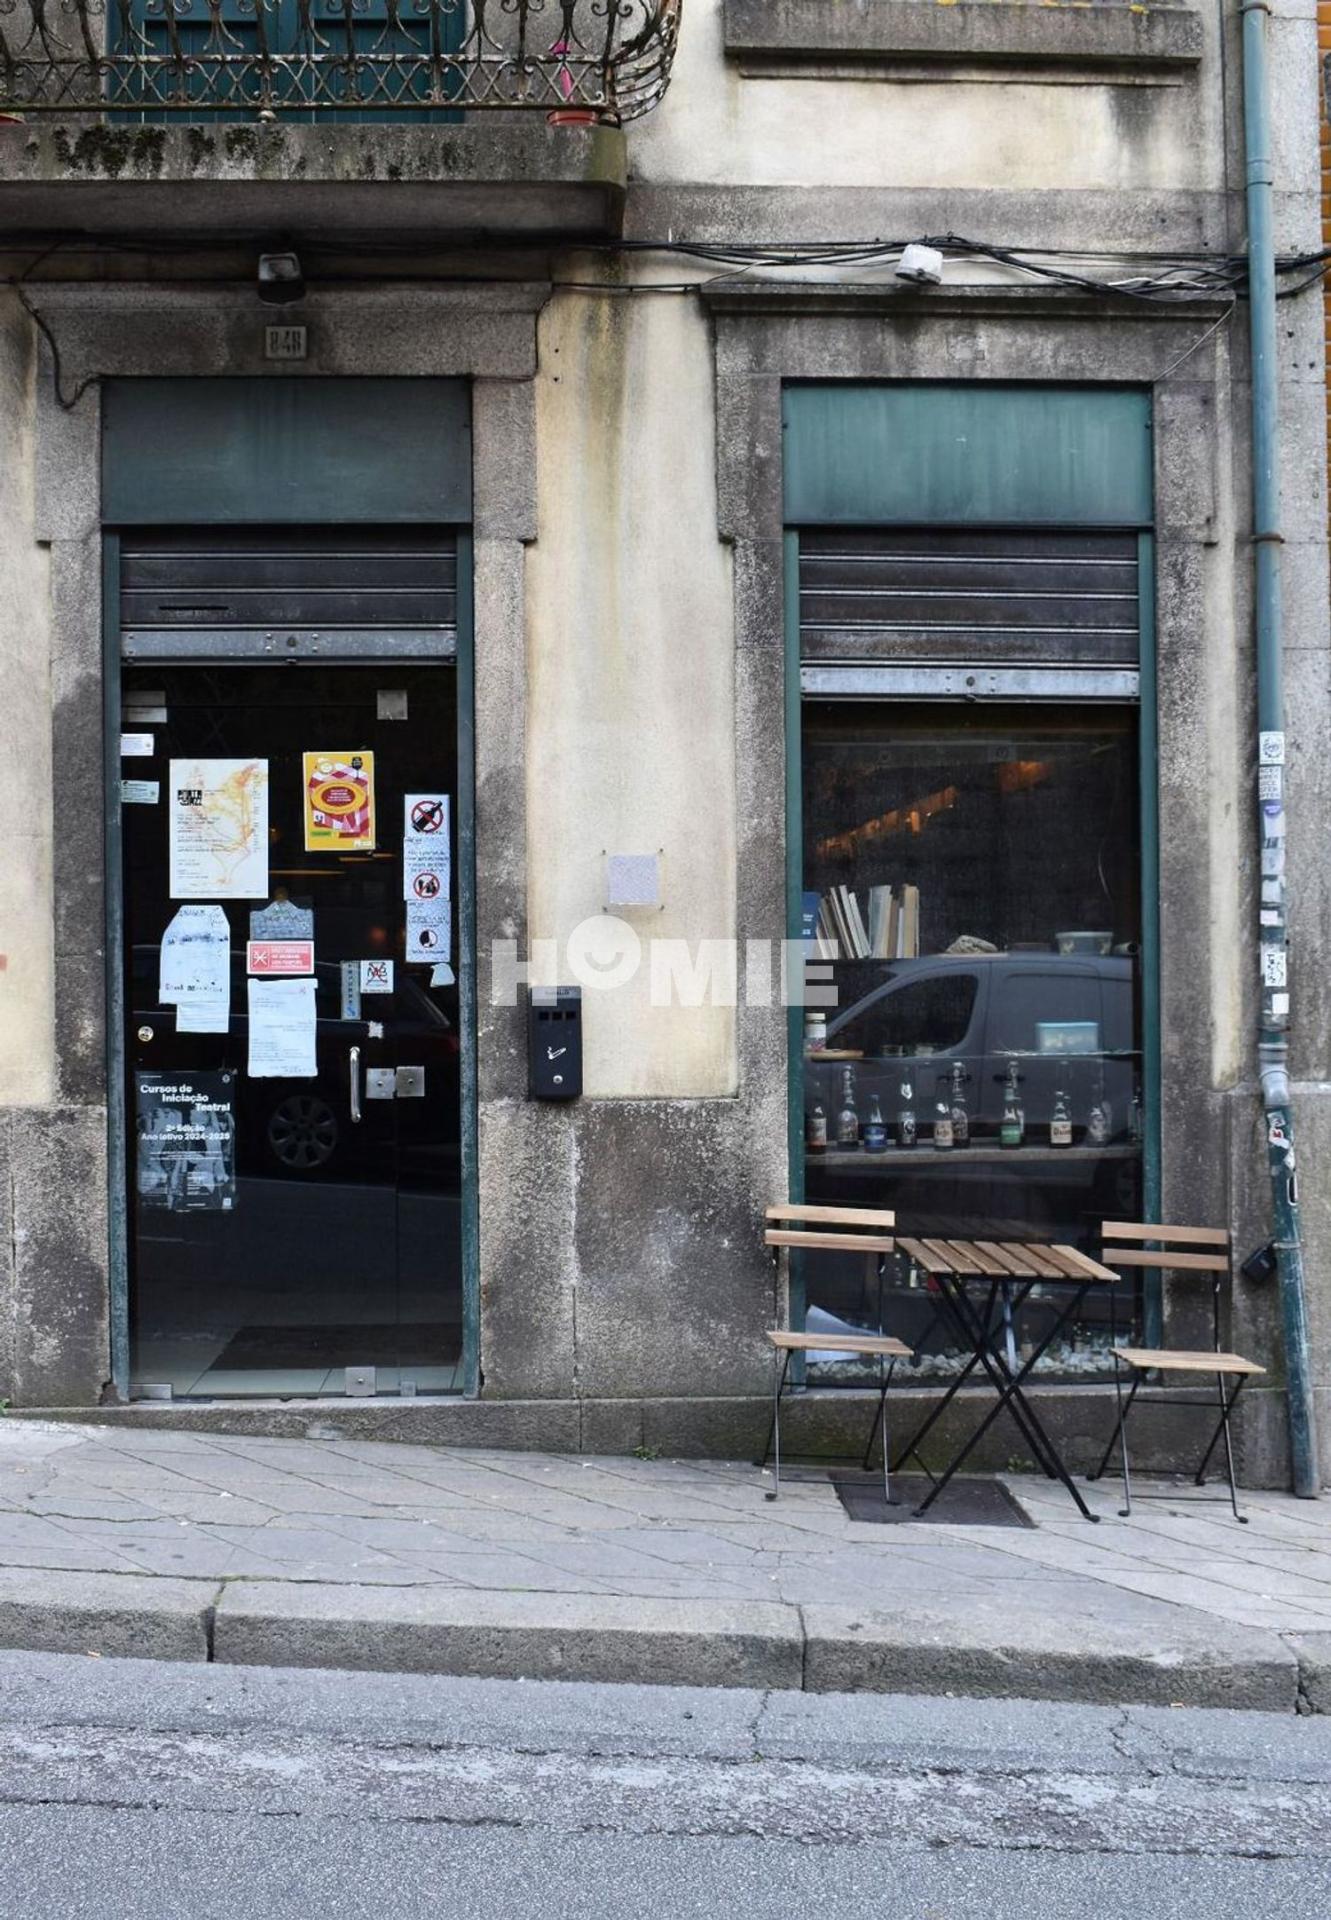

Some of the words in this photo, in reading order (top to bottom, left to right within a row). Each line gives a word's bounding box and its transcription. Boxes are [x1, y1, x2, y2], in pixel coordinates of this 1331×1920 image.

[140, 1084, 178, 1094] Cursos
[179, 1083, 193, 1093] de
[162, 1092, 209, 1104] Iniciação
[195, 1102, 231, 1112] Teatral
[141, 1132, 159, 1140] Ano
